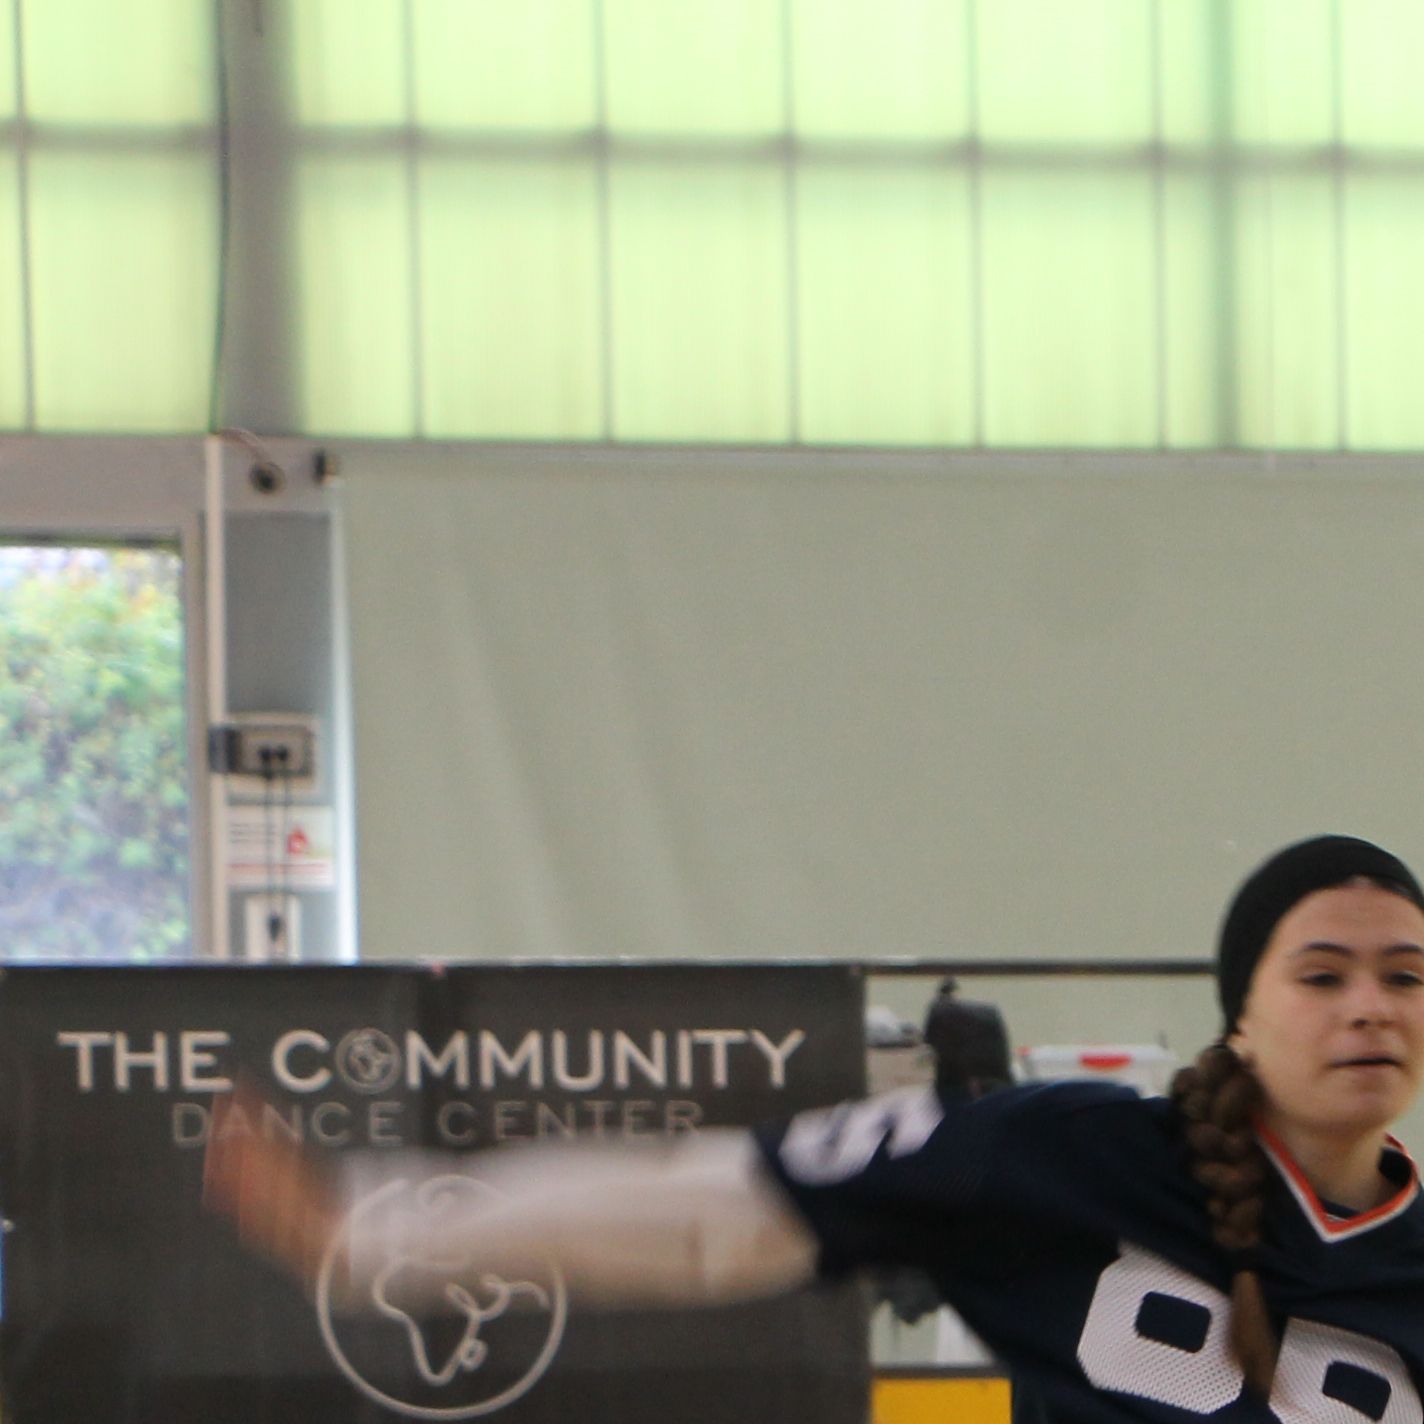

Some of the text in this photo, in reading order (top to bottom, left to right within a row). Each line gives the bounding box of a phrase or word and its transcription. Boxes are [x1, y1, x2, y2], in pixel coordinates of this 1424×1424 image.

[57, 1027, 805, 1094] THE COMMUNITY
[172, 1099, 704, 1148] DANCE CENTER
